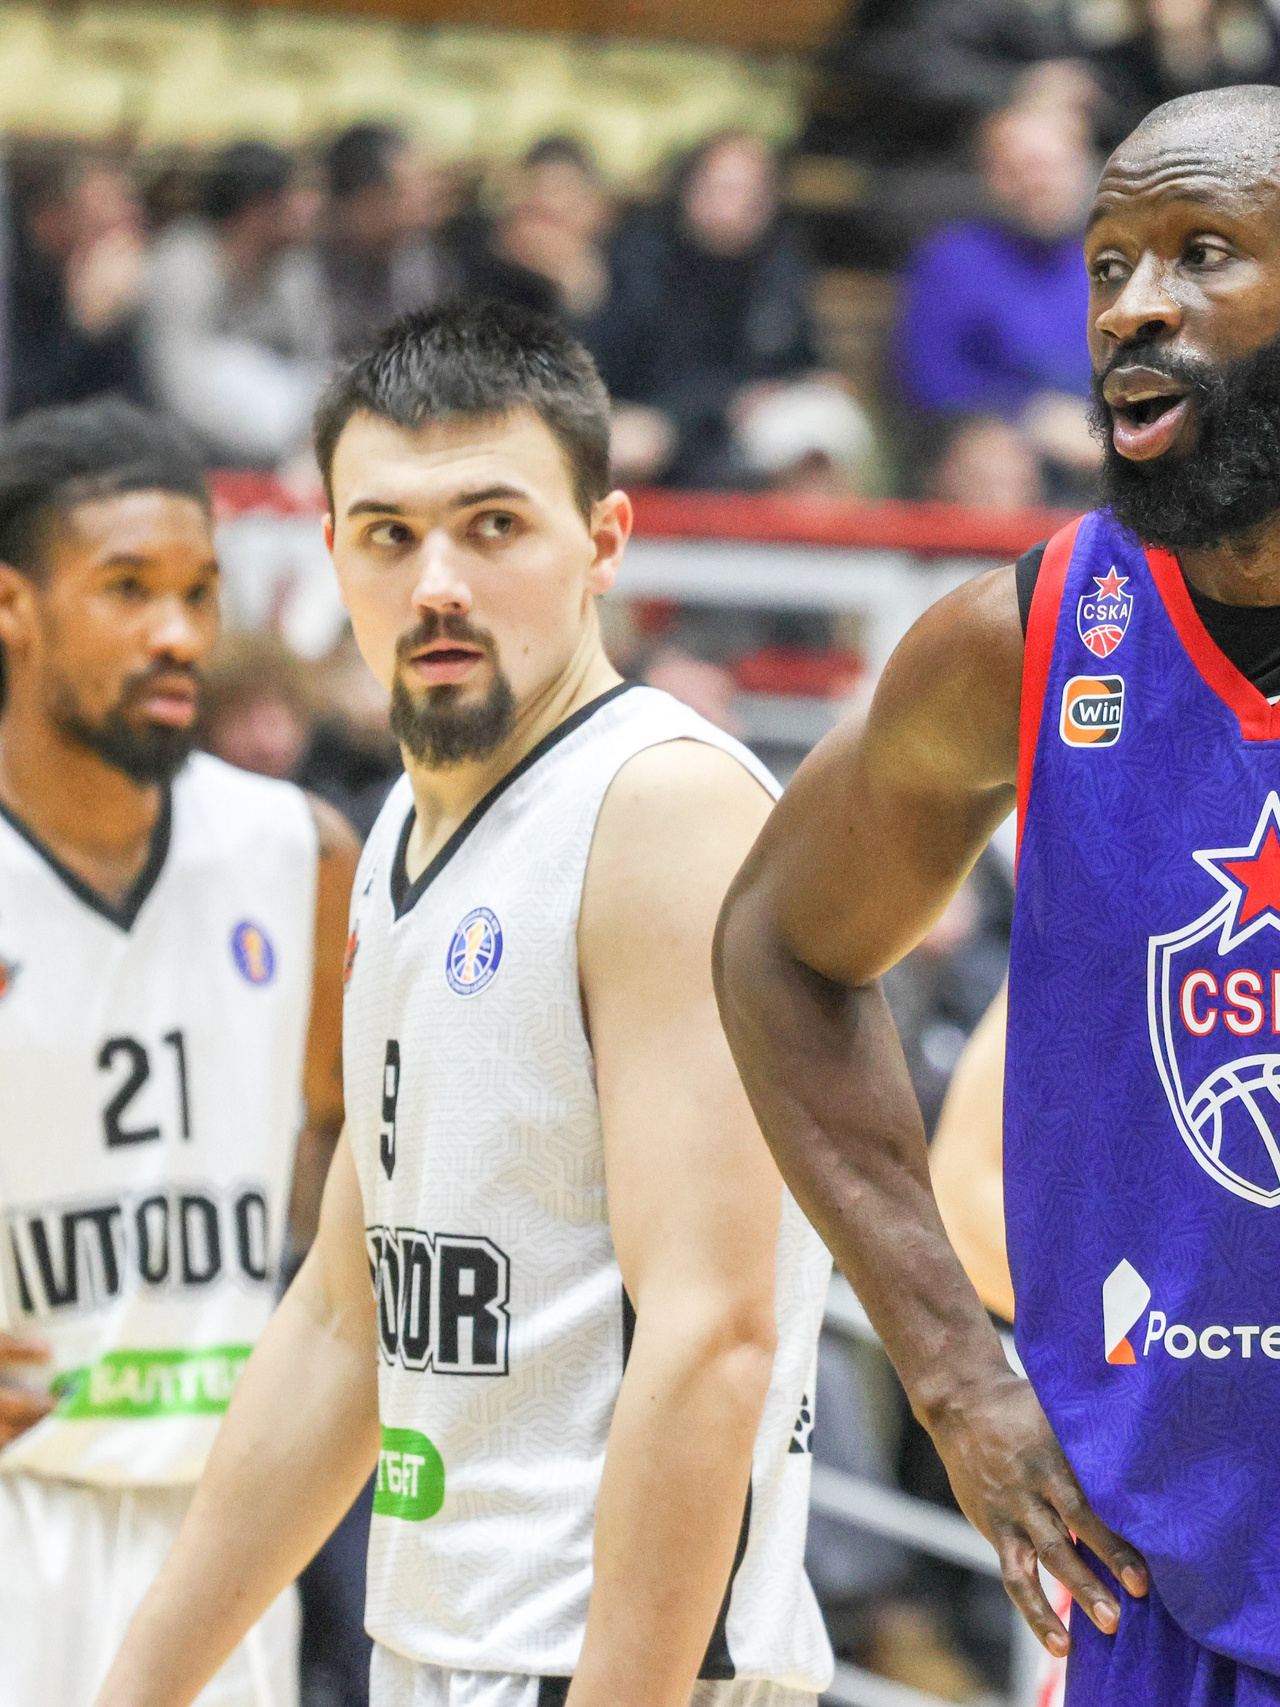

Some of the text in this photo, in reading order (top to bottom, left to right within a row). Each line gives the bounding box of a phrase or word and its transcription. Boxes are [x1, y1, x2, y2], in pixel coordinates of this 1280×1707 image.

[1083, 603, 1128, 620] CSKA
[1078, 702, 1120, 723] Win
[99, 1029, 191, 1149] 21
[380, 1039, 400, 1180] 9
